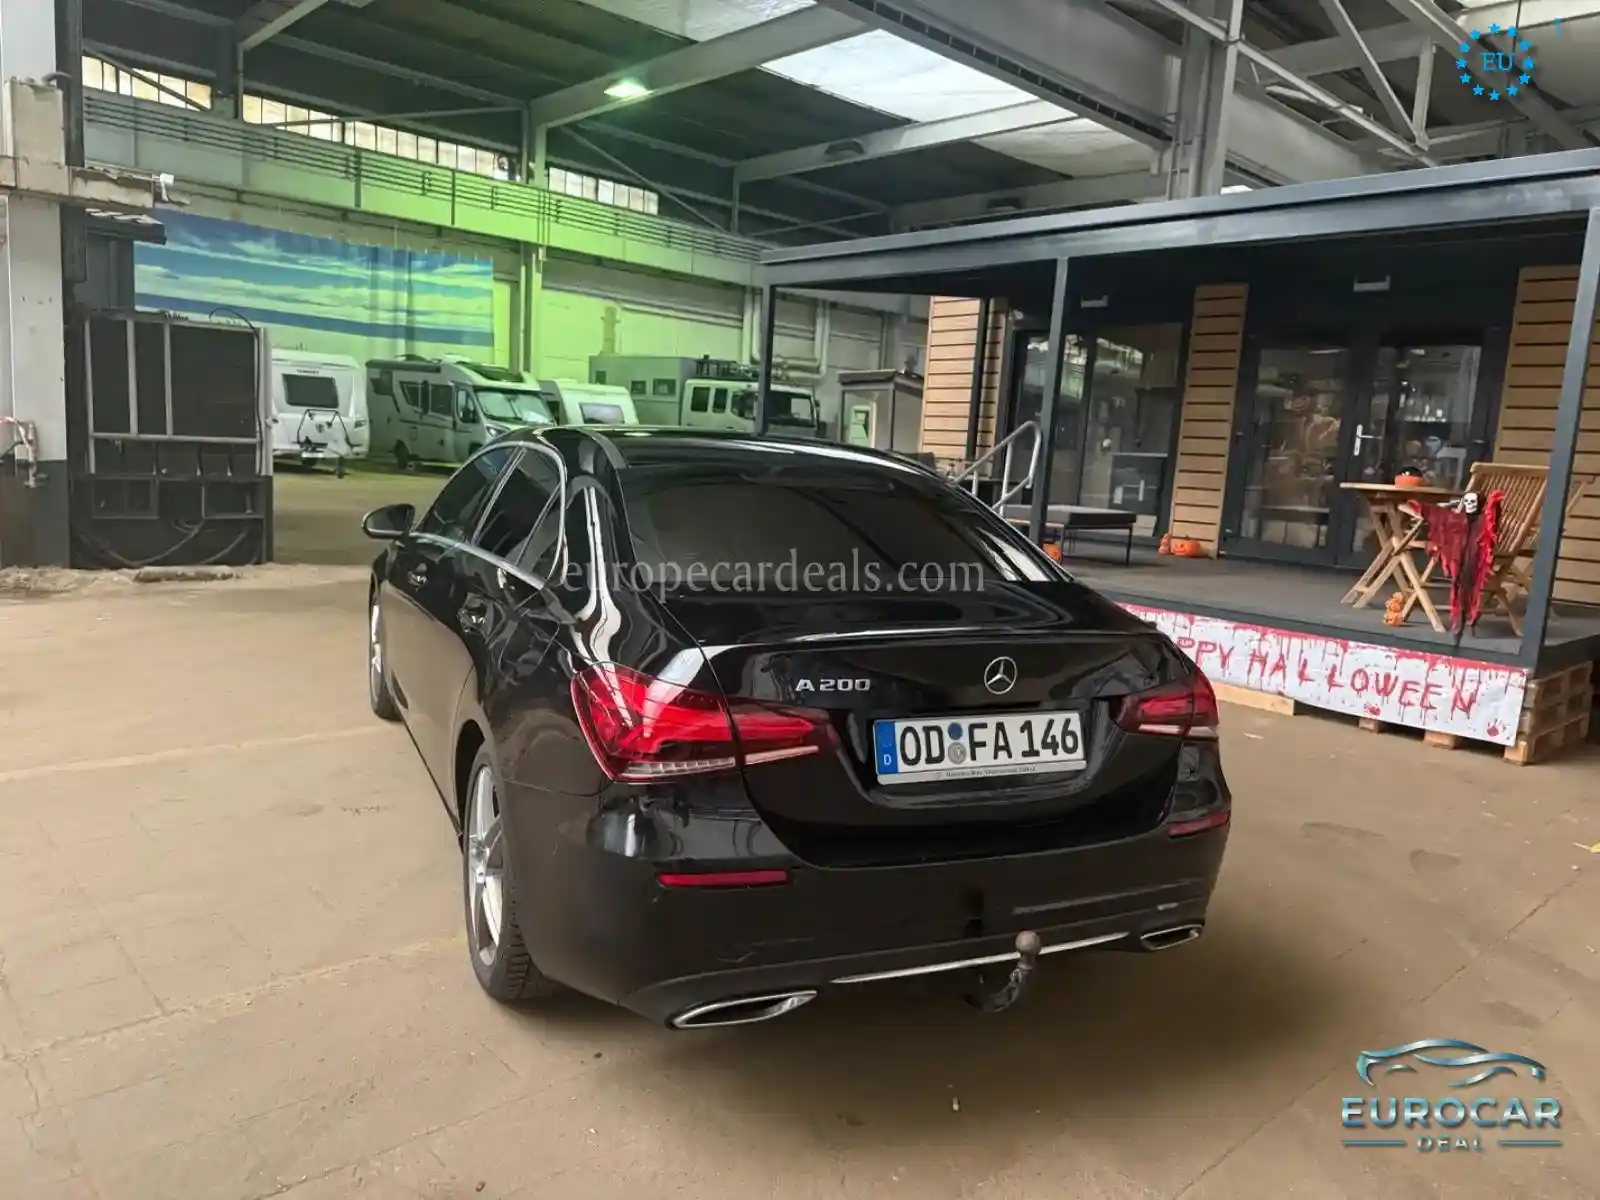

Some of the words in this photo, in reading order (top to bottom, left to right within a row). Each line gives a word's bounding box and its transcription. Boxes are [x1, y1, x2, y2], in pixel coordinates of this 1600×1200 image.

[795, 678, 816, 692] A
[819, 678, 871, 692] 200
[1176, 636, 1235, 672] PPY
[1247, 648, 1480, 717] HALLOWEEN
[900, 725, 946, 766] OD
[883, 754, 892, 766] D
